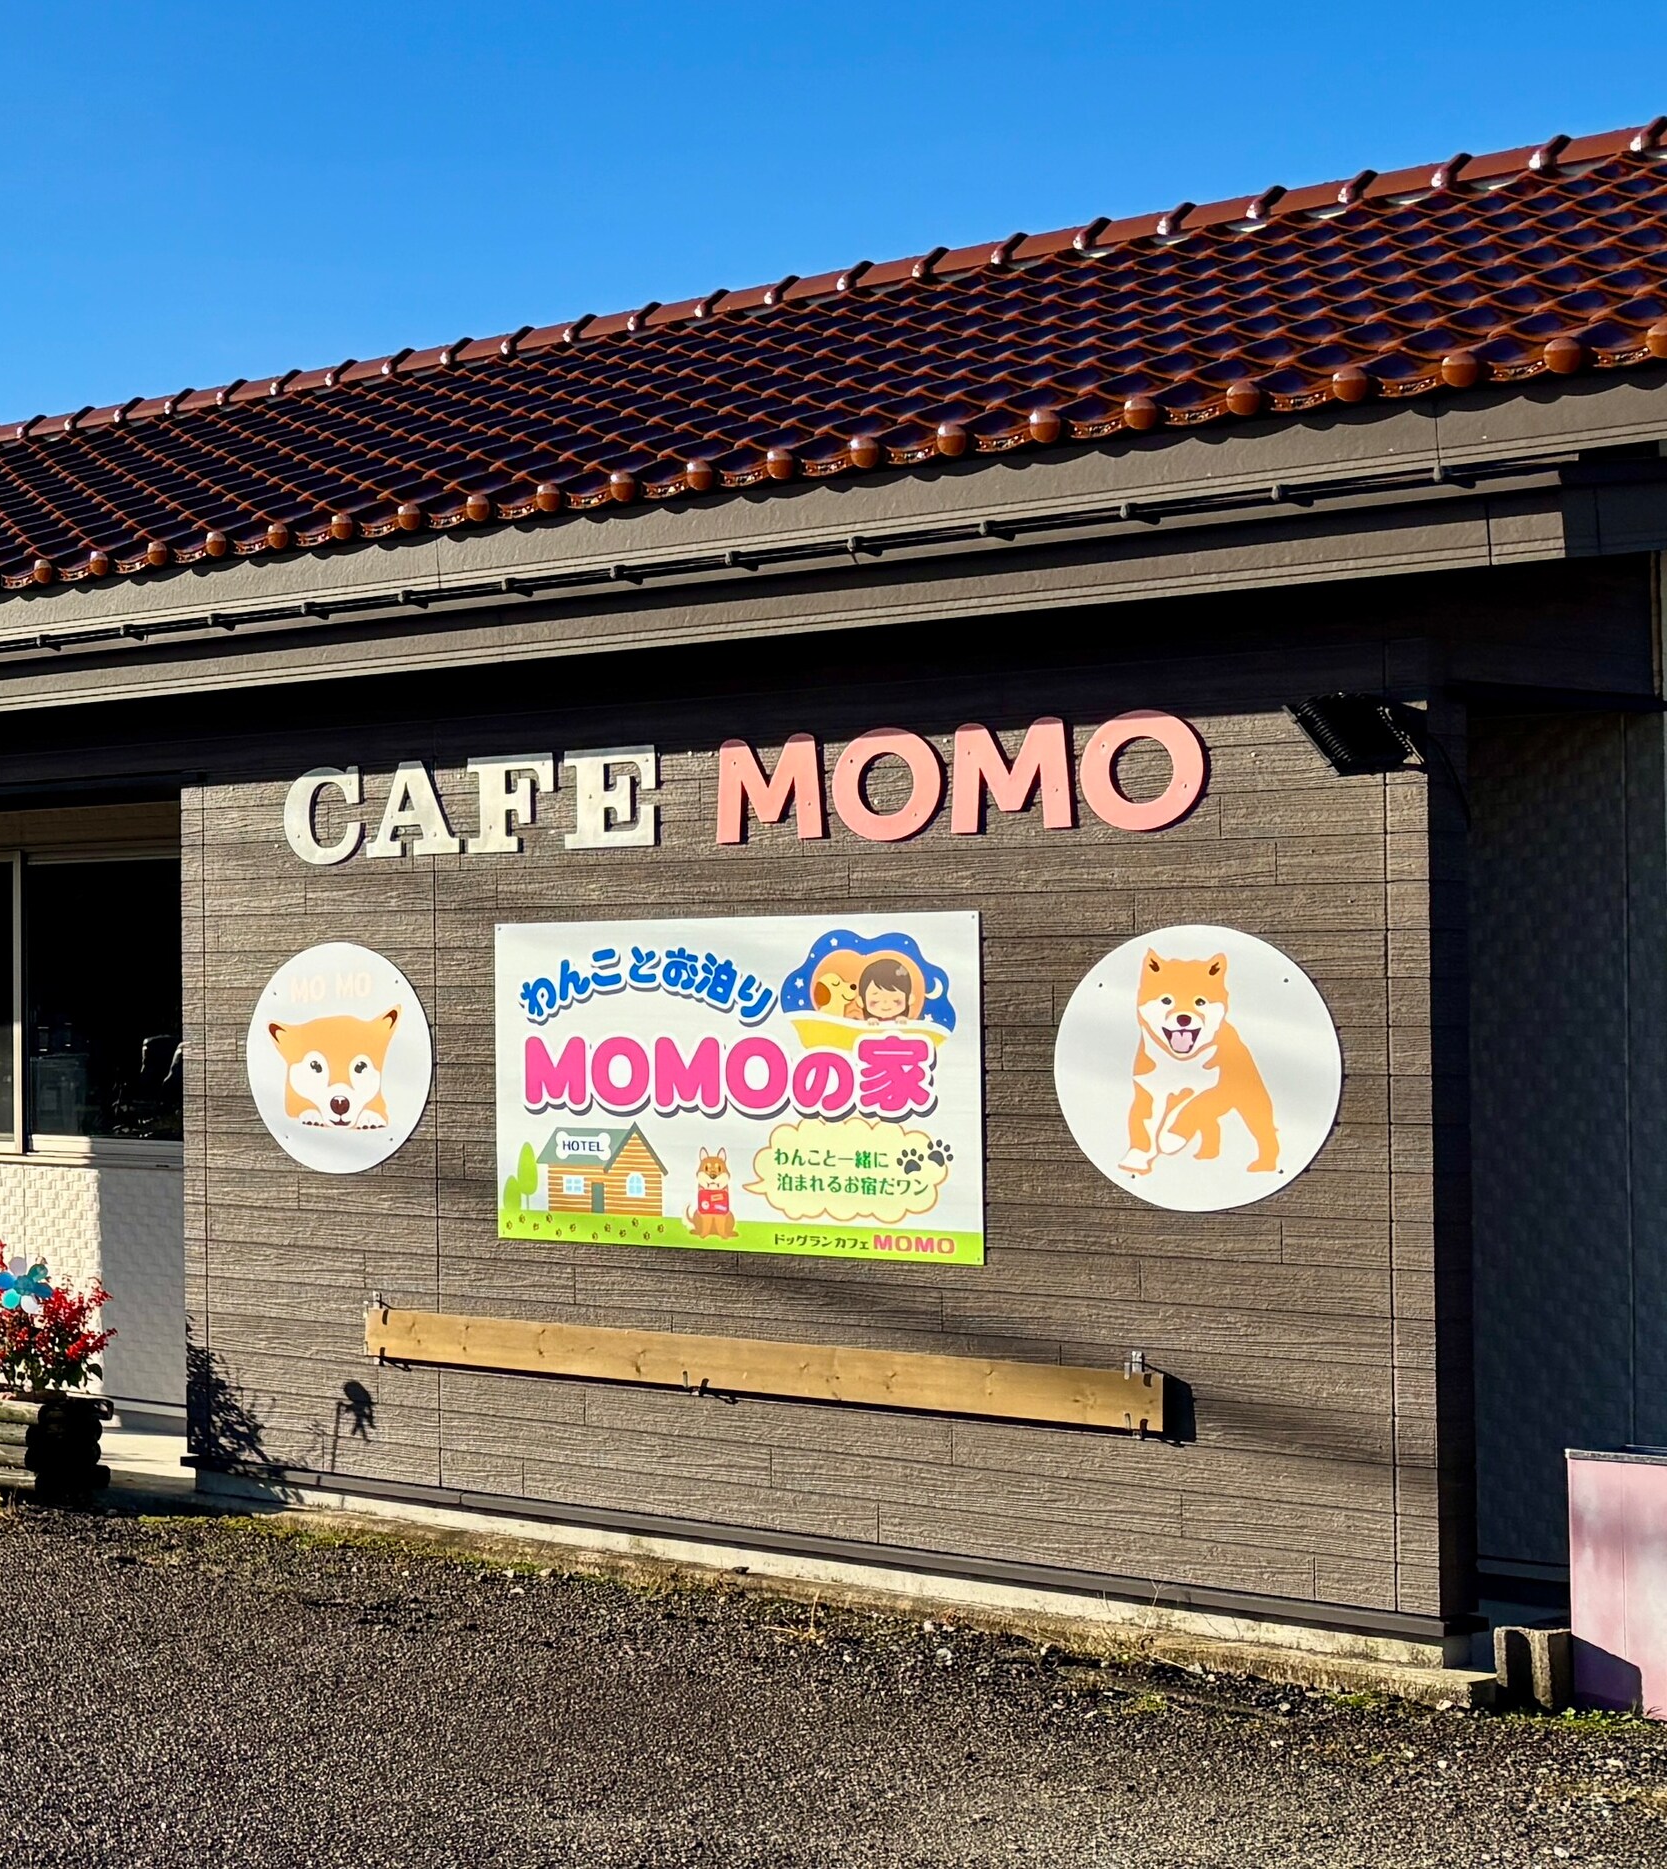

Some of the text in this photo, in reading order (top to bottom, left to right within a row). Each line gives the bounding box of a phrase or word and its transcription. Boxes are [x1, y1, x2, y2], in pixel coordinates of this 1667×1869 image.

[283, 709, 1205, 865] CAFE MOMO
[520, 946, 777, 1019] わんことお泊り
[523, 1035, 933, 1111] MOMOの家
[562, 1140, 605, 1152] HOTEL
[774, 1148, 889, 1169] わんこと一緒に
[776, 1173, 929, 1196] 泊まれるお宿だワン
[774, 1233, 956, 1255] ドッグランカフェ MOMO
